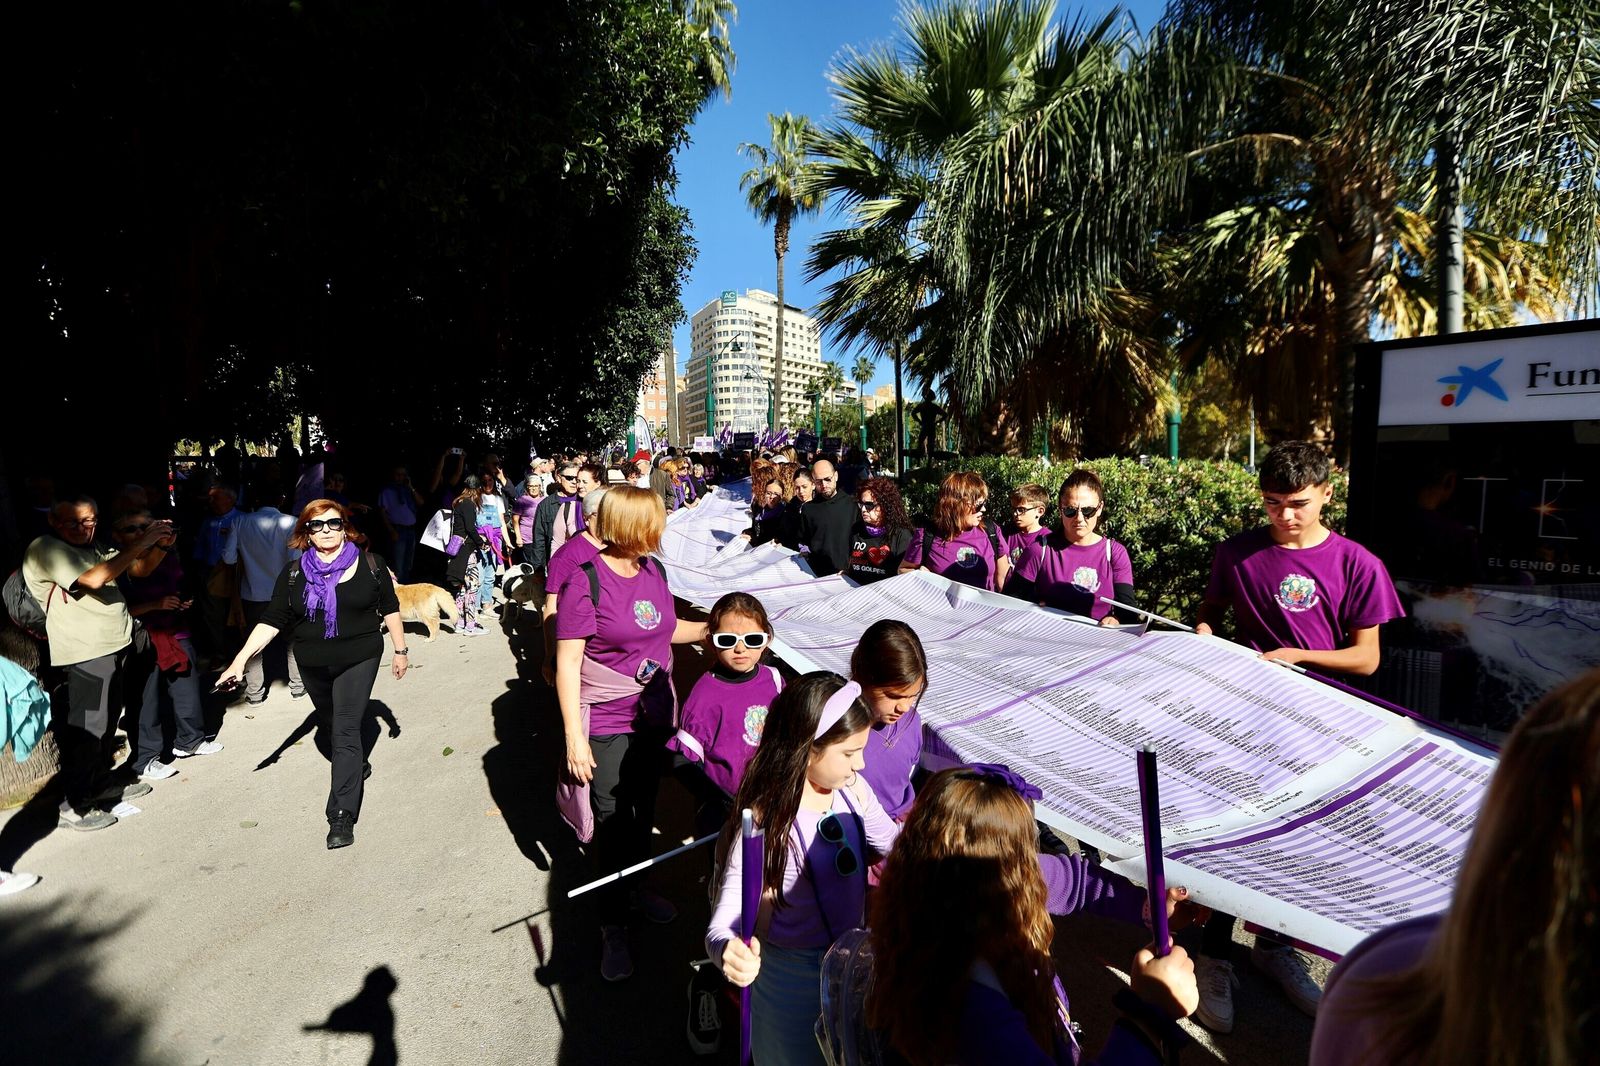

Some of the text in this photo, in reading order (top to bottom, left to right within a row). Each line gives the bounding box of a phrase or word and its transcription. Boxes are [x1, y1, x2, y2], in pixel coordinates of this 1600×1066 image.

[853, 541, 867, 551] no
[1487, 557, 1504, 568] EL
[1509, 559, 1555, 572] GENIO
[1560, 563, 1581, 574] DE
